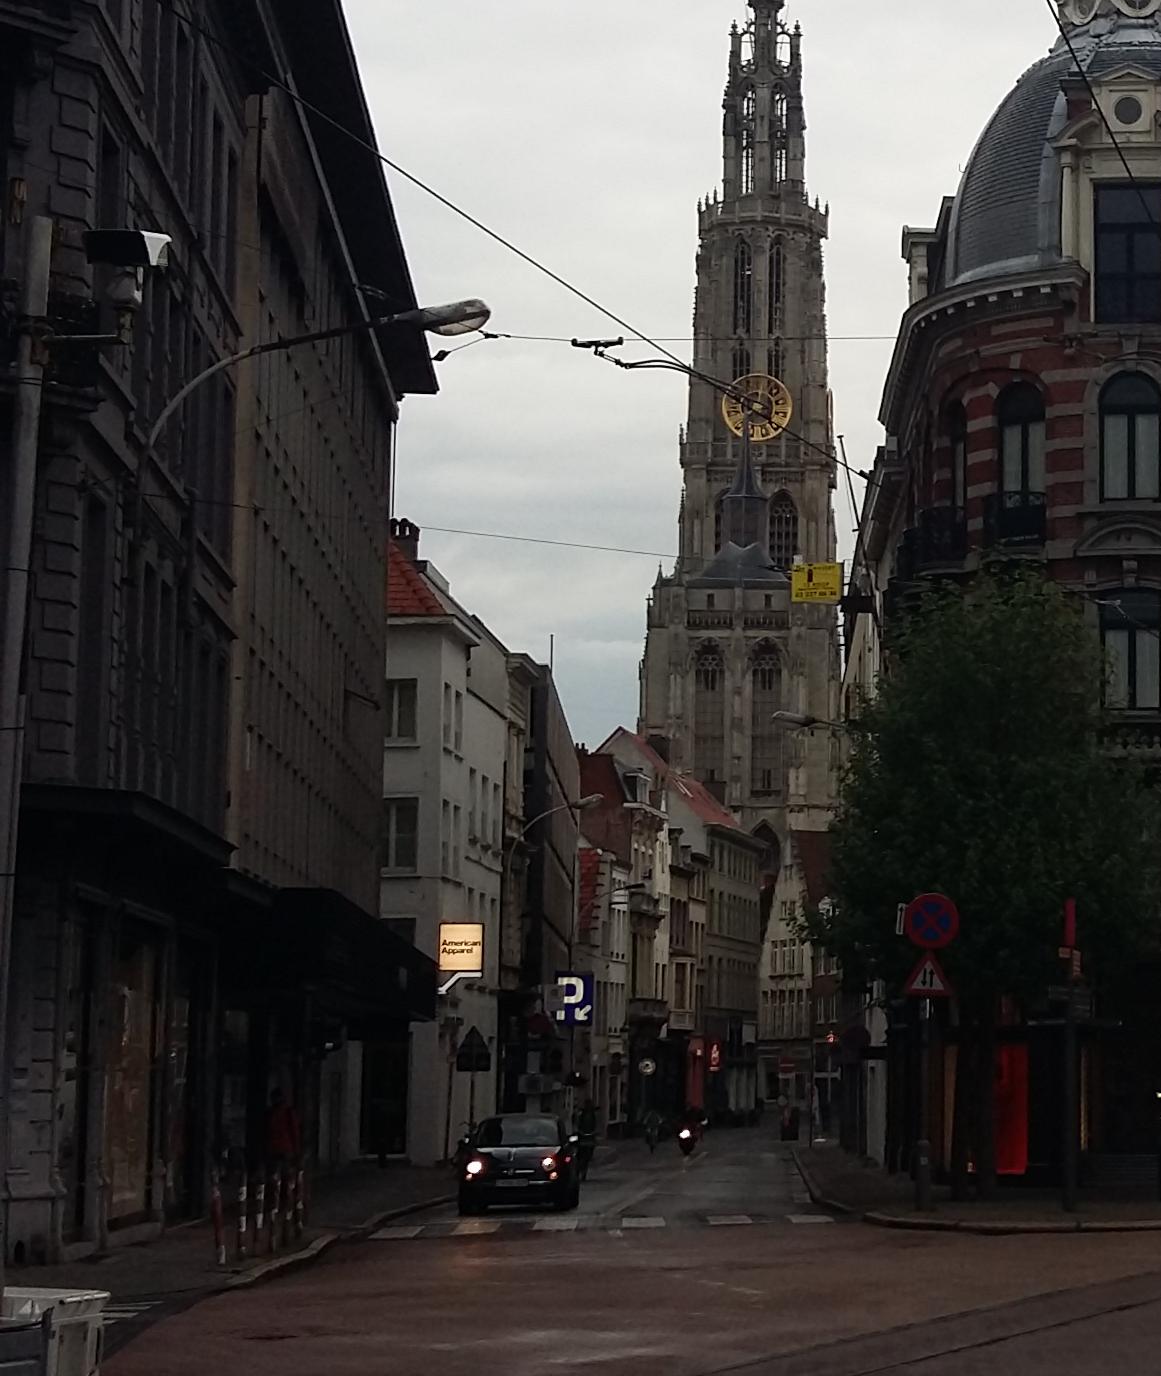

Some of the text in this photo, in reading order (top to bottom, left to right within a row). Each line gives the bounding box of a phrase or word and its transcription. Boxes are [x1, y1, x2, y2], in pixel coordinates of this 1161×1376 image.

[441, 939, 481, 947] American
[441, 947, 474, 955] Apparel
[556, 976, 585, 1021] P
